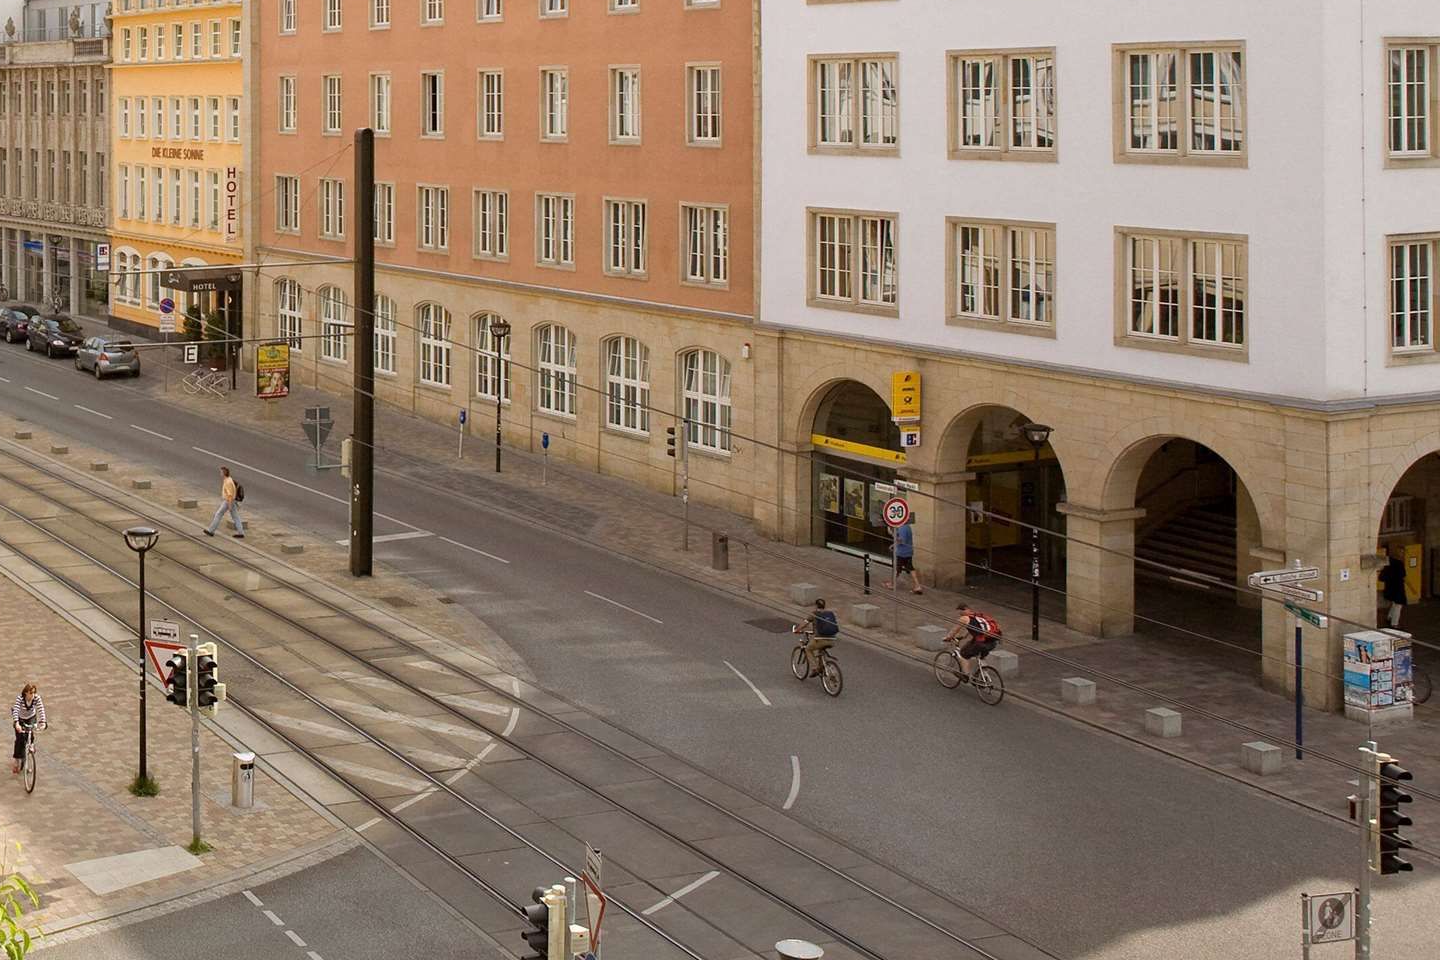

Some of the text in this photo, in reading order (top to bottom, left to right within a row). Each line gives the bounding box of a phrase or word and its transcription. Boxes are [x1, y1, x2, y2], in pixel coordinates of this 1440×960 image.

[152, 147, 204, 160] DIE KLEINE SONNE
[226, 167, 236, 234] HOTEL
[187, 347, 196, 362] E
[889, 506, 904, 519] 30
